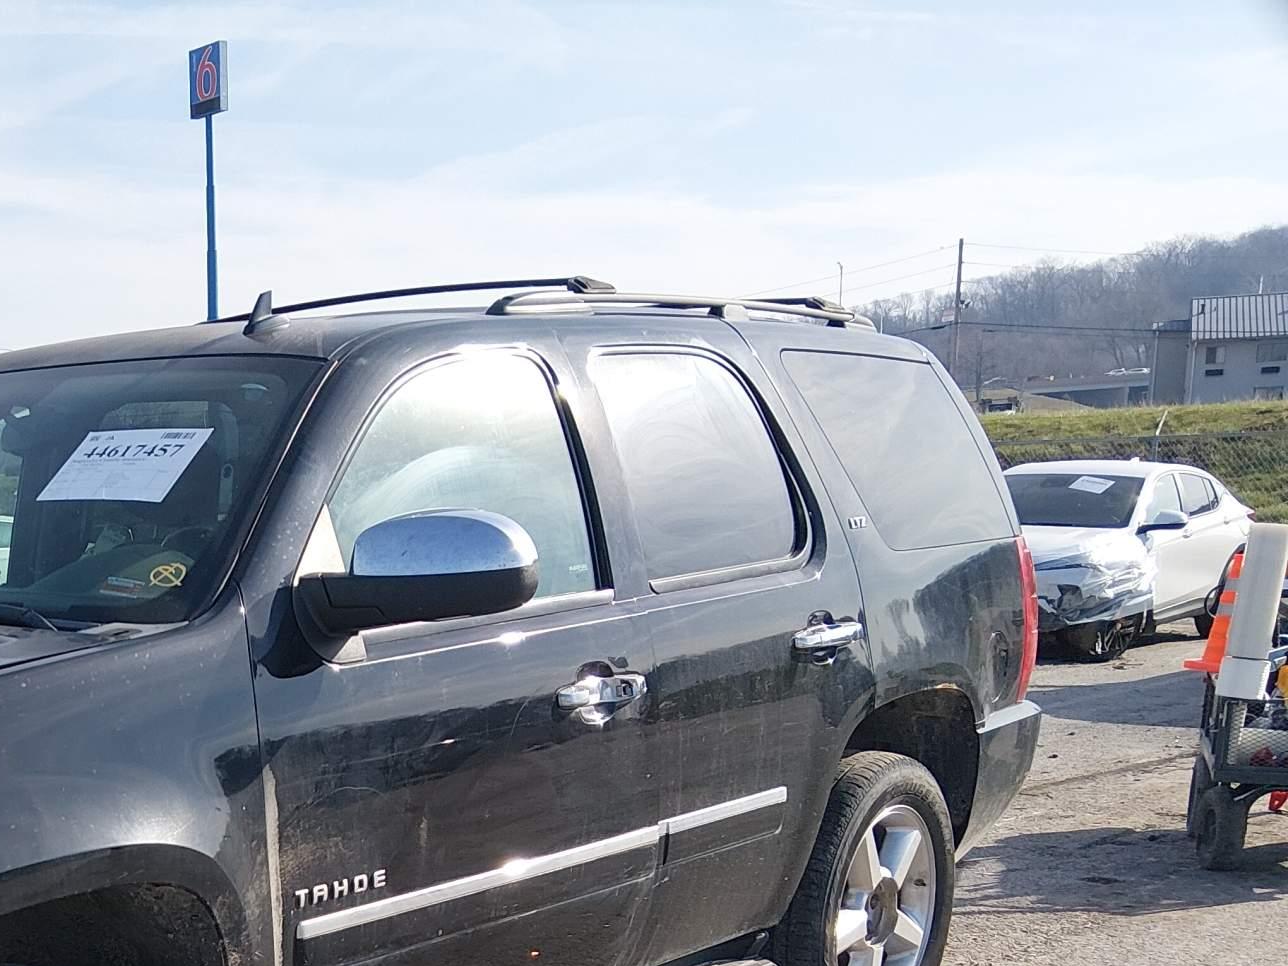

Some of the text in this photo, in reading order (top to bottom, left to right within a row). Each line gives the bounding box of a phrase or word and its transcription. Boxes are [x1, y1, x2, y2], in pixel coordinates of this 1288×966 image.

[196, 45, 217, 101] 6
[83, 444, 185, 458] 44617457
[848, 516, 867, 529] LTZ
[294, 868, 387, 908] TAHOE
